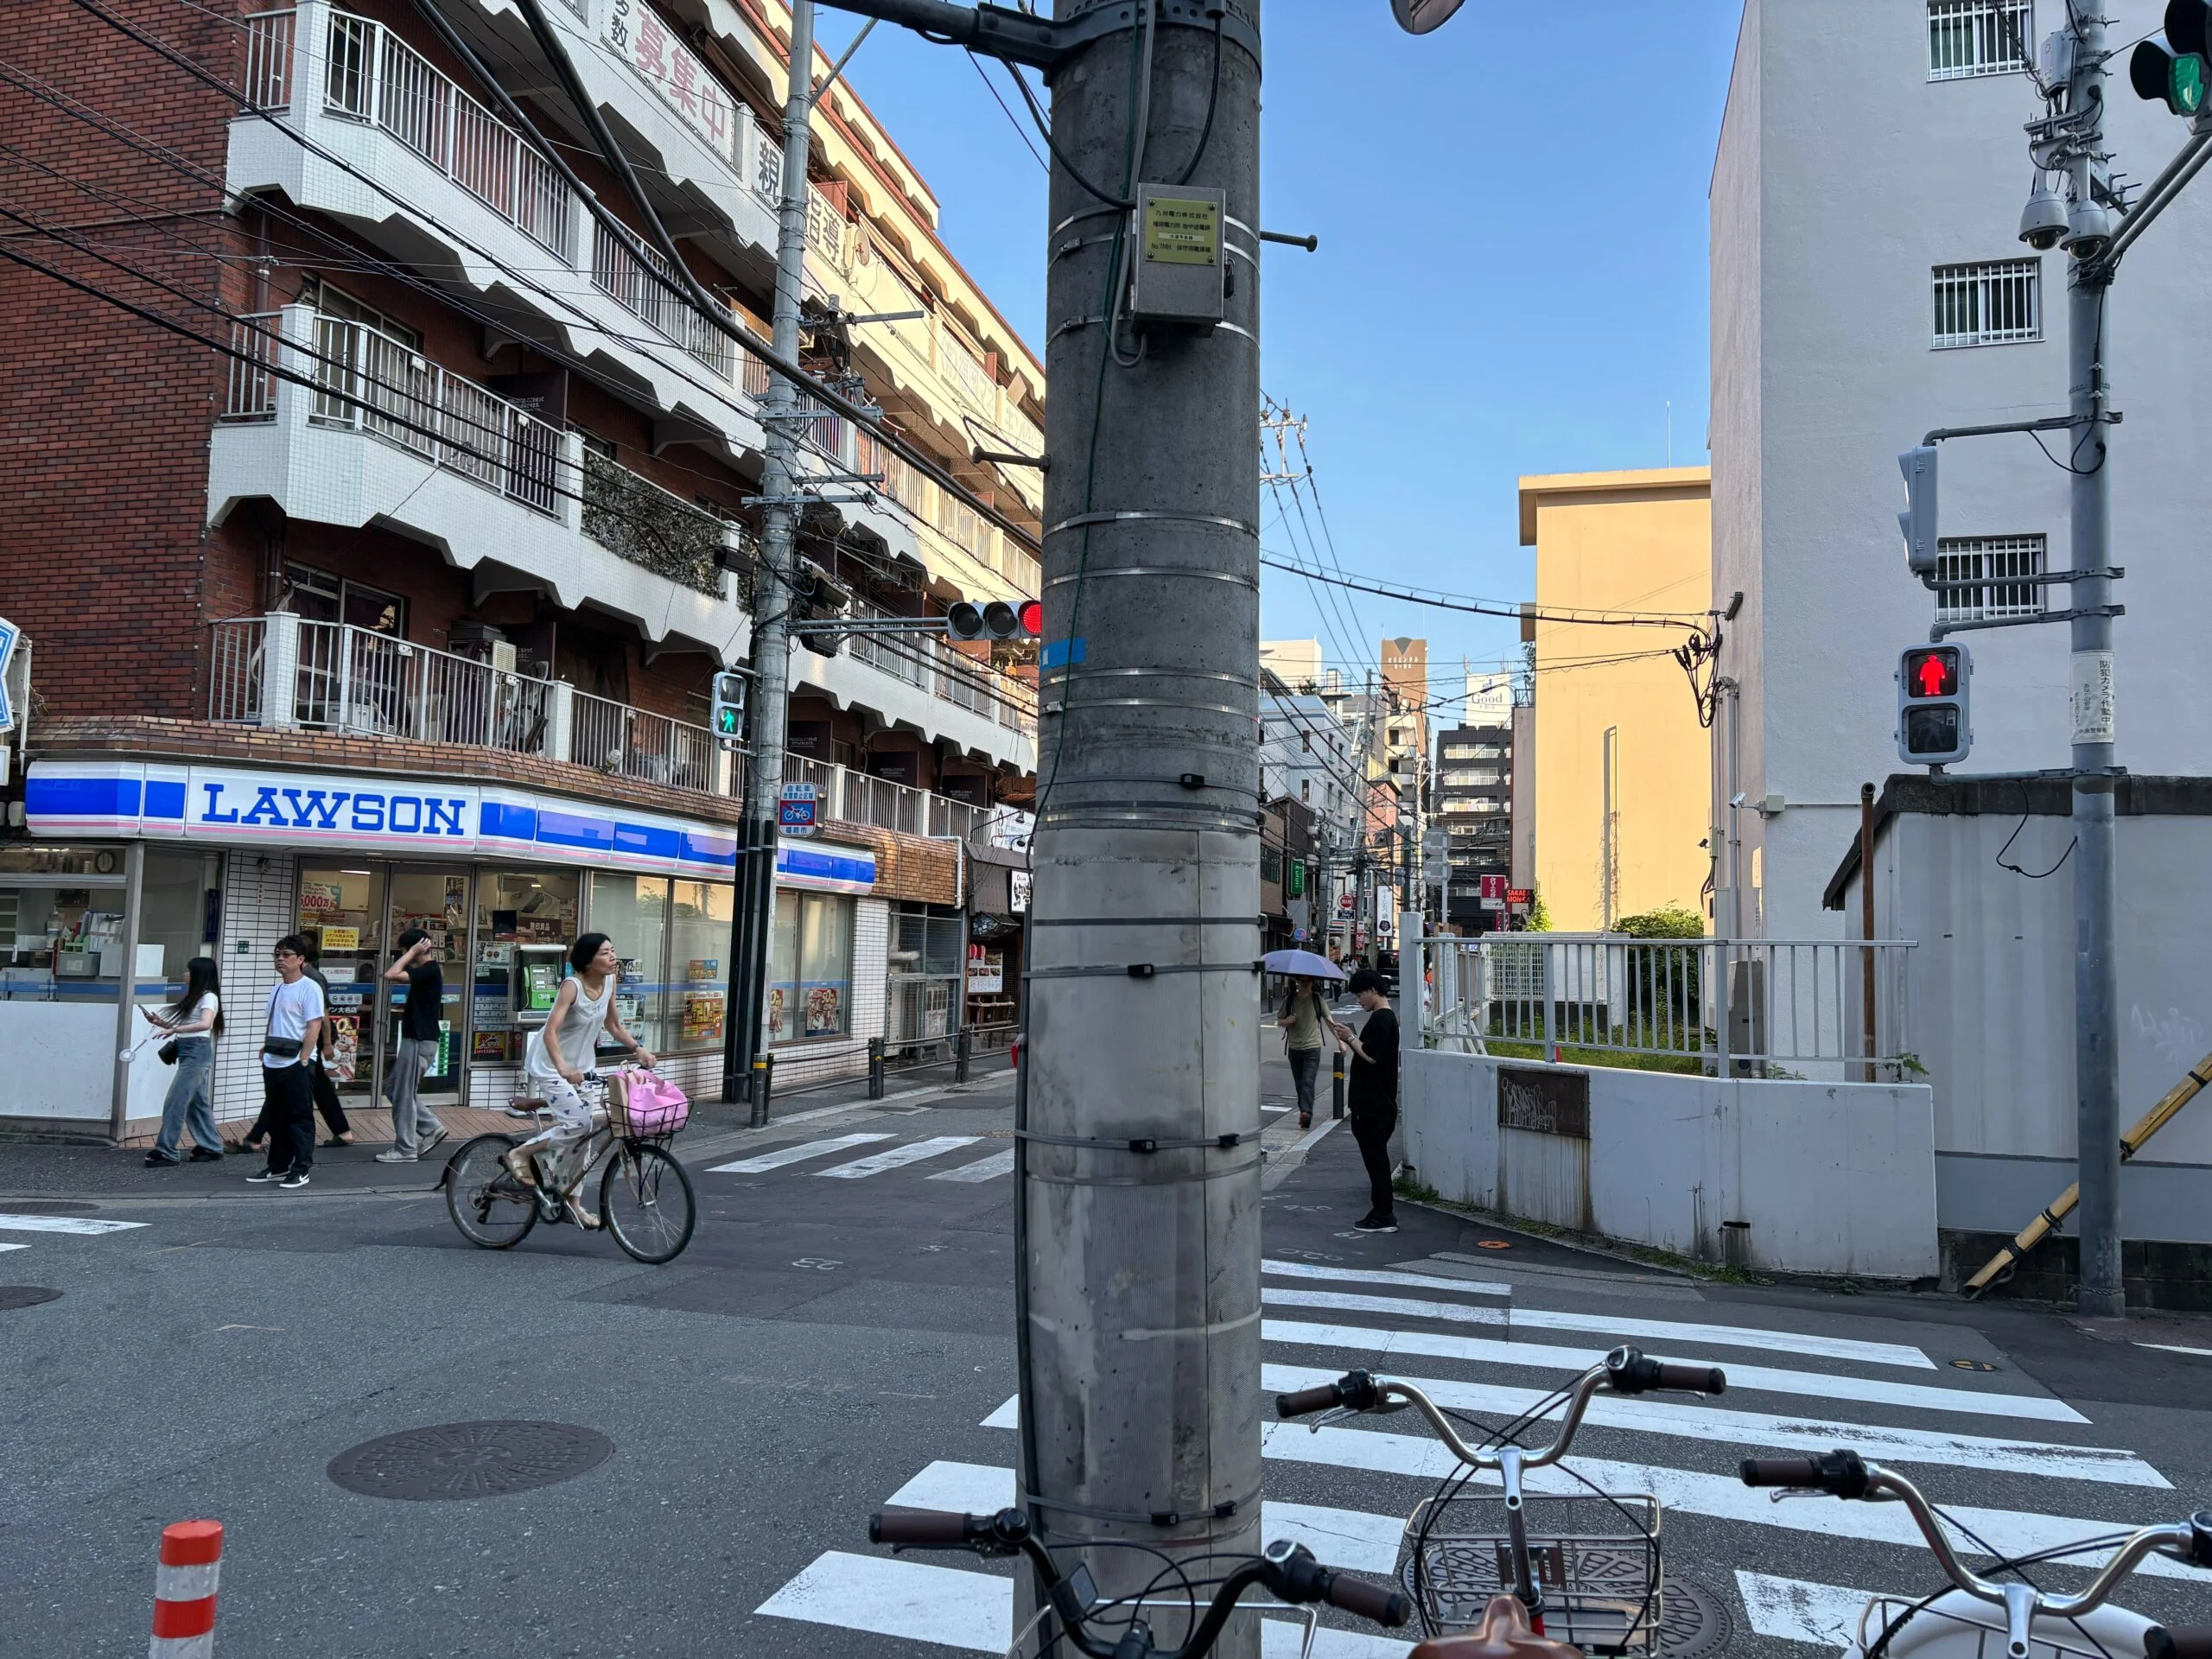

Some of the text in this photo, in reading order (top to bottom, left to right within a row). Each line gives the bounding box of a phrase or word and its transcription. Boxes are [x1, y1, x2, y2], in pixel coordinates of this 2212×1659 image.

[635, 7, 726, 142] 募集中
[1155, 210, 1209, 220] 九州電力株式会社
[1471, 693, 1503, 704] Good
[2099, 660, 2112, 725] 防犯カメラ作動中
[201, 782, 467, 836] LAWSON
